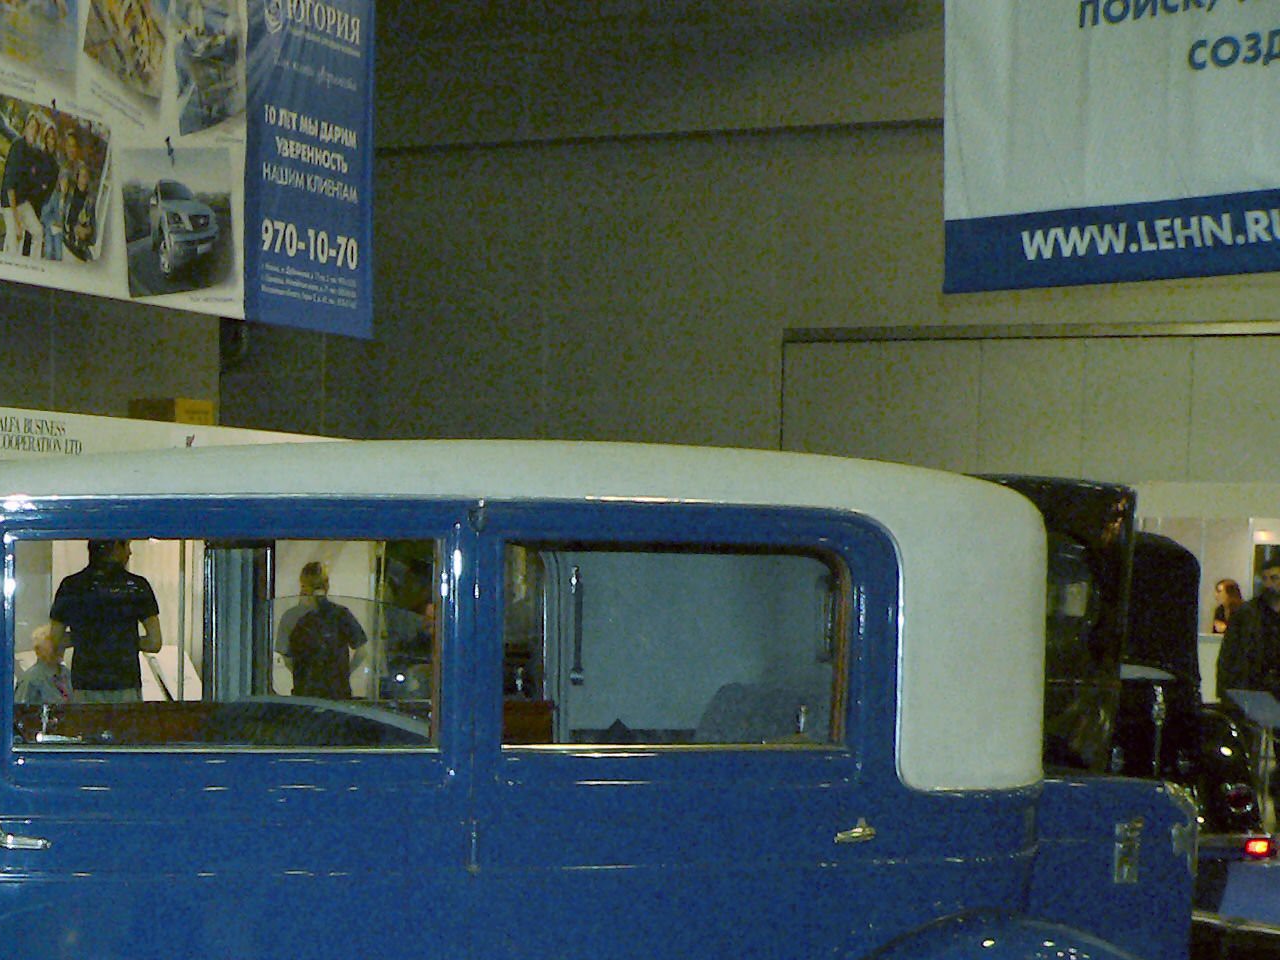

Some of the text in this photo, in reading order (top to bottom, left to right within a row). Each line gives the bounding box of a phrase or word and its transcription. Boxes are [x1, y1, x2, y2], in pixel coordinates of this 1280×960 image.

[264, 104, 357, 149] 10 ЛЕТ МЫ ДАРИМ
[275, 136, 349, 174] УВЕРЕННОСТЬ
[263, 162, 358, 204] НАШИМ КЛИЕНТАМ
[261, 218, 358, 271] 970-10-70
[0, 416, 66, 437] ALFA BUSINESS
[64, 438, 85, 456] LTD
